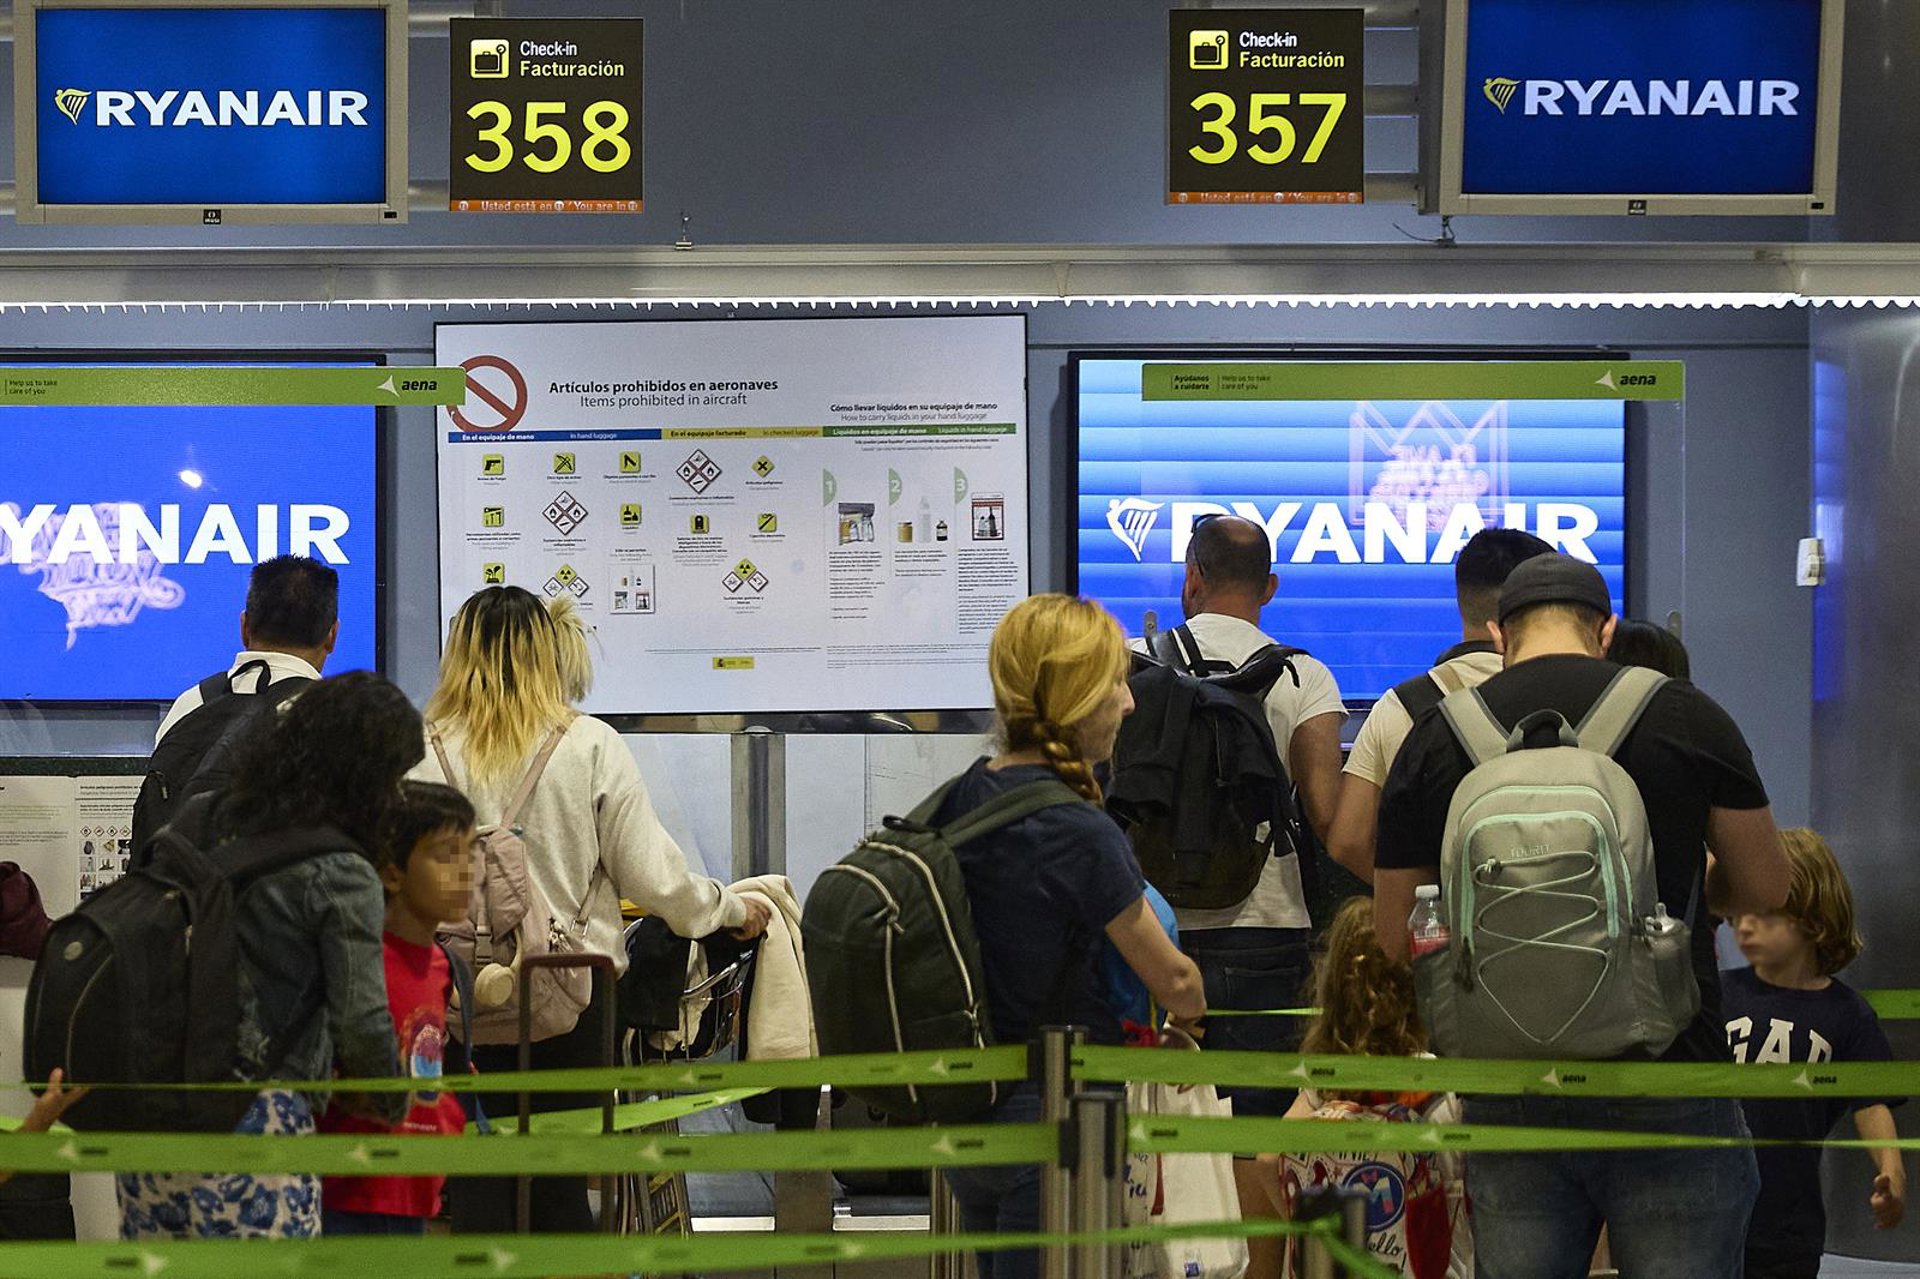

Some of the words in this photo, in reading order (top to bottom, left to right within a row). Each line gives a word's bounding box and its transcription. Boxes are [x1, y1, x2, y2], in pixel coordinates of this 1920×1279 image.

[1239, 31, 1297, 47] Check-in
[520, 41, 577, 56] Check-in
[1239, 51, 1345, 68] Facturación
[520, 60, 624, 76] Facturación
[1524, 80, 1799, 116] RYANAIR
[96, 90, 368, 126] RYANAIR
[1188, 92, 1347, 164] 357
[464, 101, 631, 173] 358
[481, 201, 511, 210] Usted
[401, 380, 437, 391] aena
[549, 381, 610, 394] Artículos
[612, 380, 686, 395] prohibidos
[689, 382, 706, 391] en
[708, 381, 779, 391] aeronaves
[1620, 375, 1656, 386] aena
[580, 396, 616, 407] Items
[618, 394, 684, 409] prohibited
[688, 395, 700, 405] in
[703, 393, 747, 405] aircraft
[478, 433, 505, 442] equipaje
[1725, 1016, 1833, 1064] GAP
